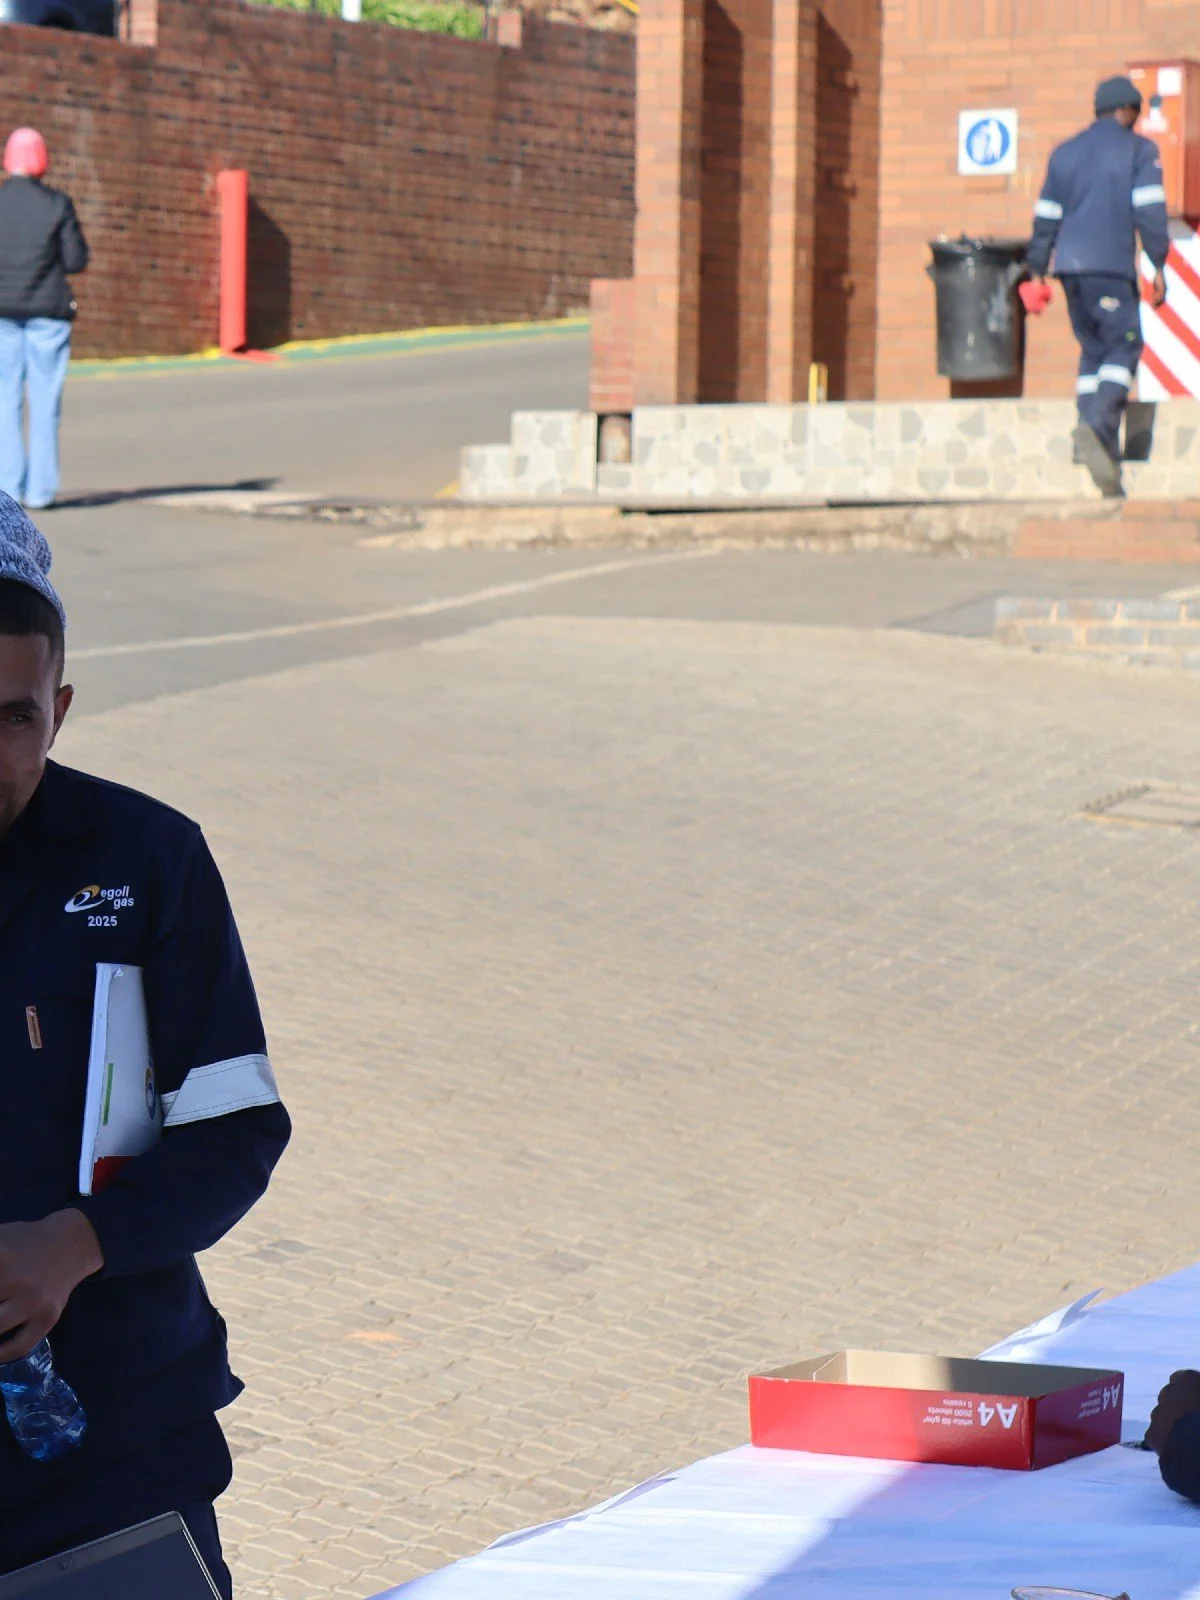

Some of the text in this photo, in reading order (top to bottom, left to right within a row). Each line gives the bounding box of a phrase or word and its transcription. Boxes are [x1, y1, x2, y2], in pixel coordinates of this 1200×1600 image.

[113, 898, 135, 910] gas
[87, 915, 118, 927] 2025
[1102, 1383, 1121, 1411] A4
[977, 1401, 1019, 1429] A4
